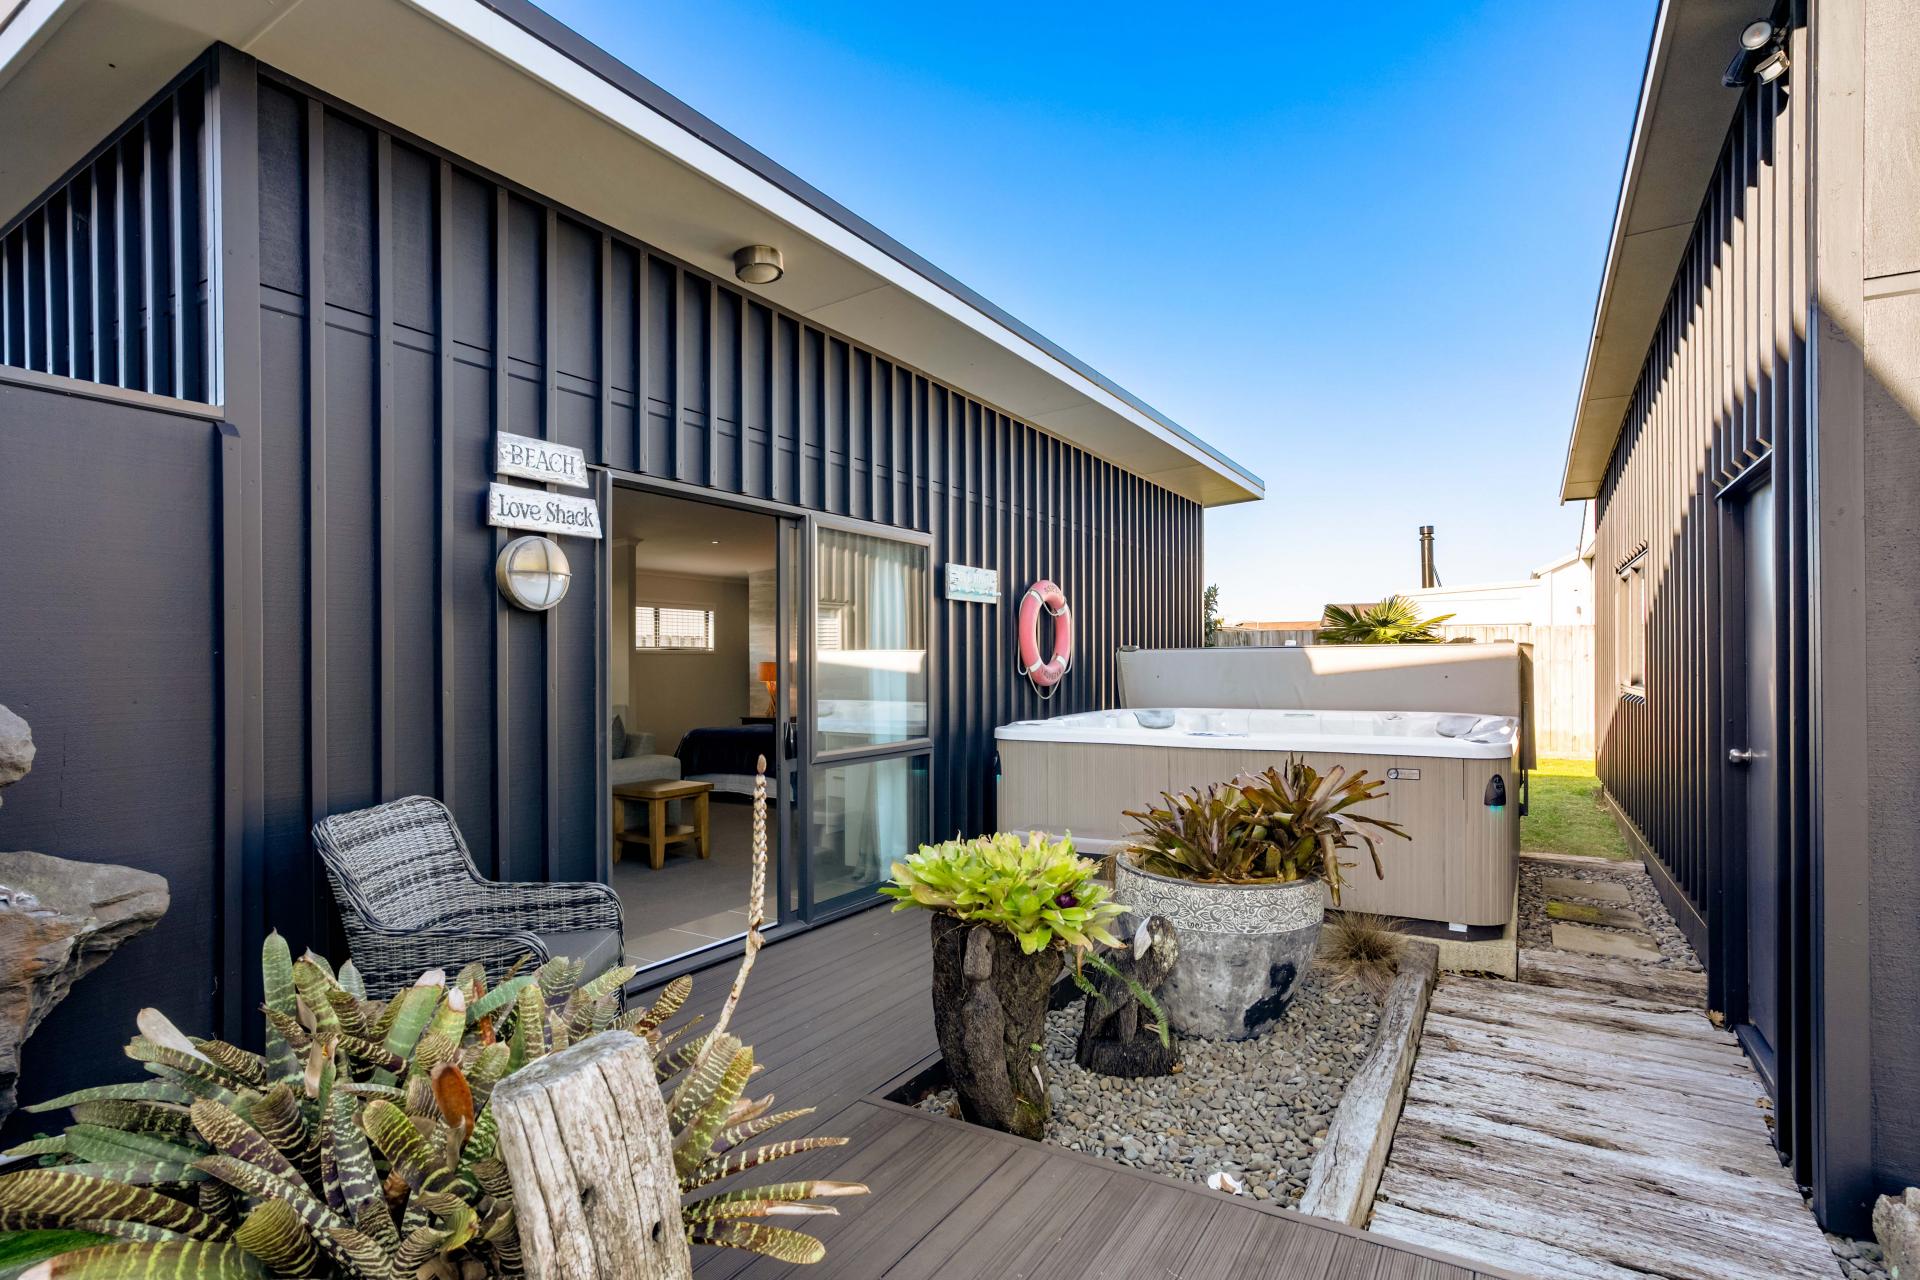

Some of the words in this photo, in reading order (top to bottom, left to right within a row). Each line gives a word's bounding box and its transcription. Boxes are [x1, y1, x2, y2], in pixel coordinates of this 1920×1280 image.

[510, 444, 575, 475] BEACH
[497, 494, 541, 521] Love
[545, 501, 594, 528] Shack
